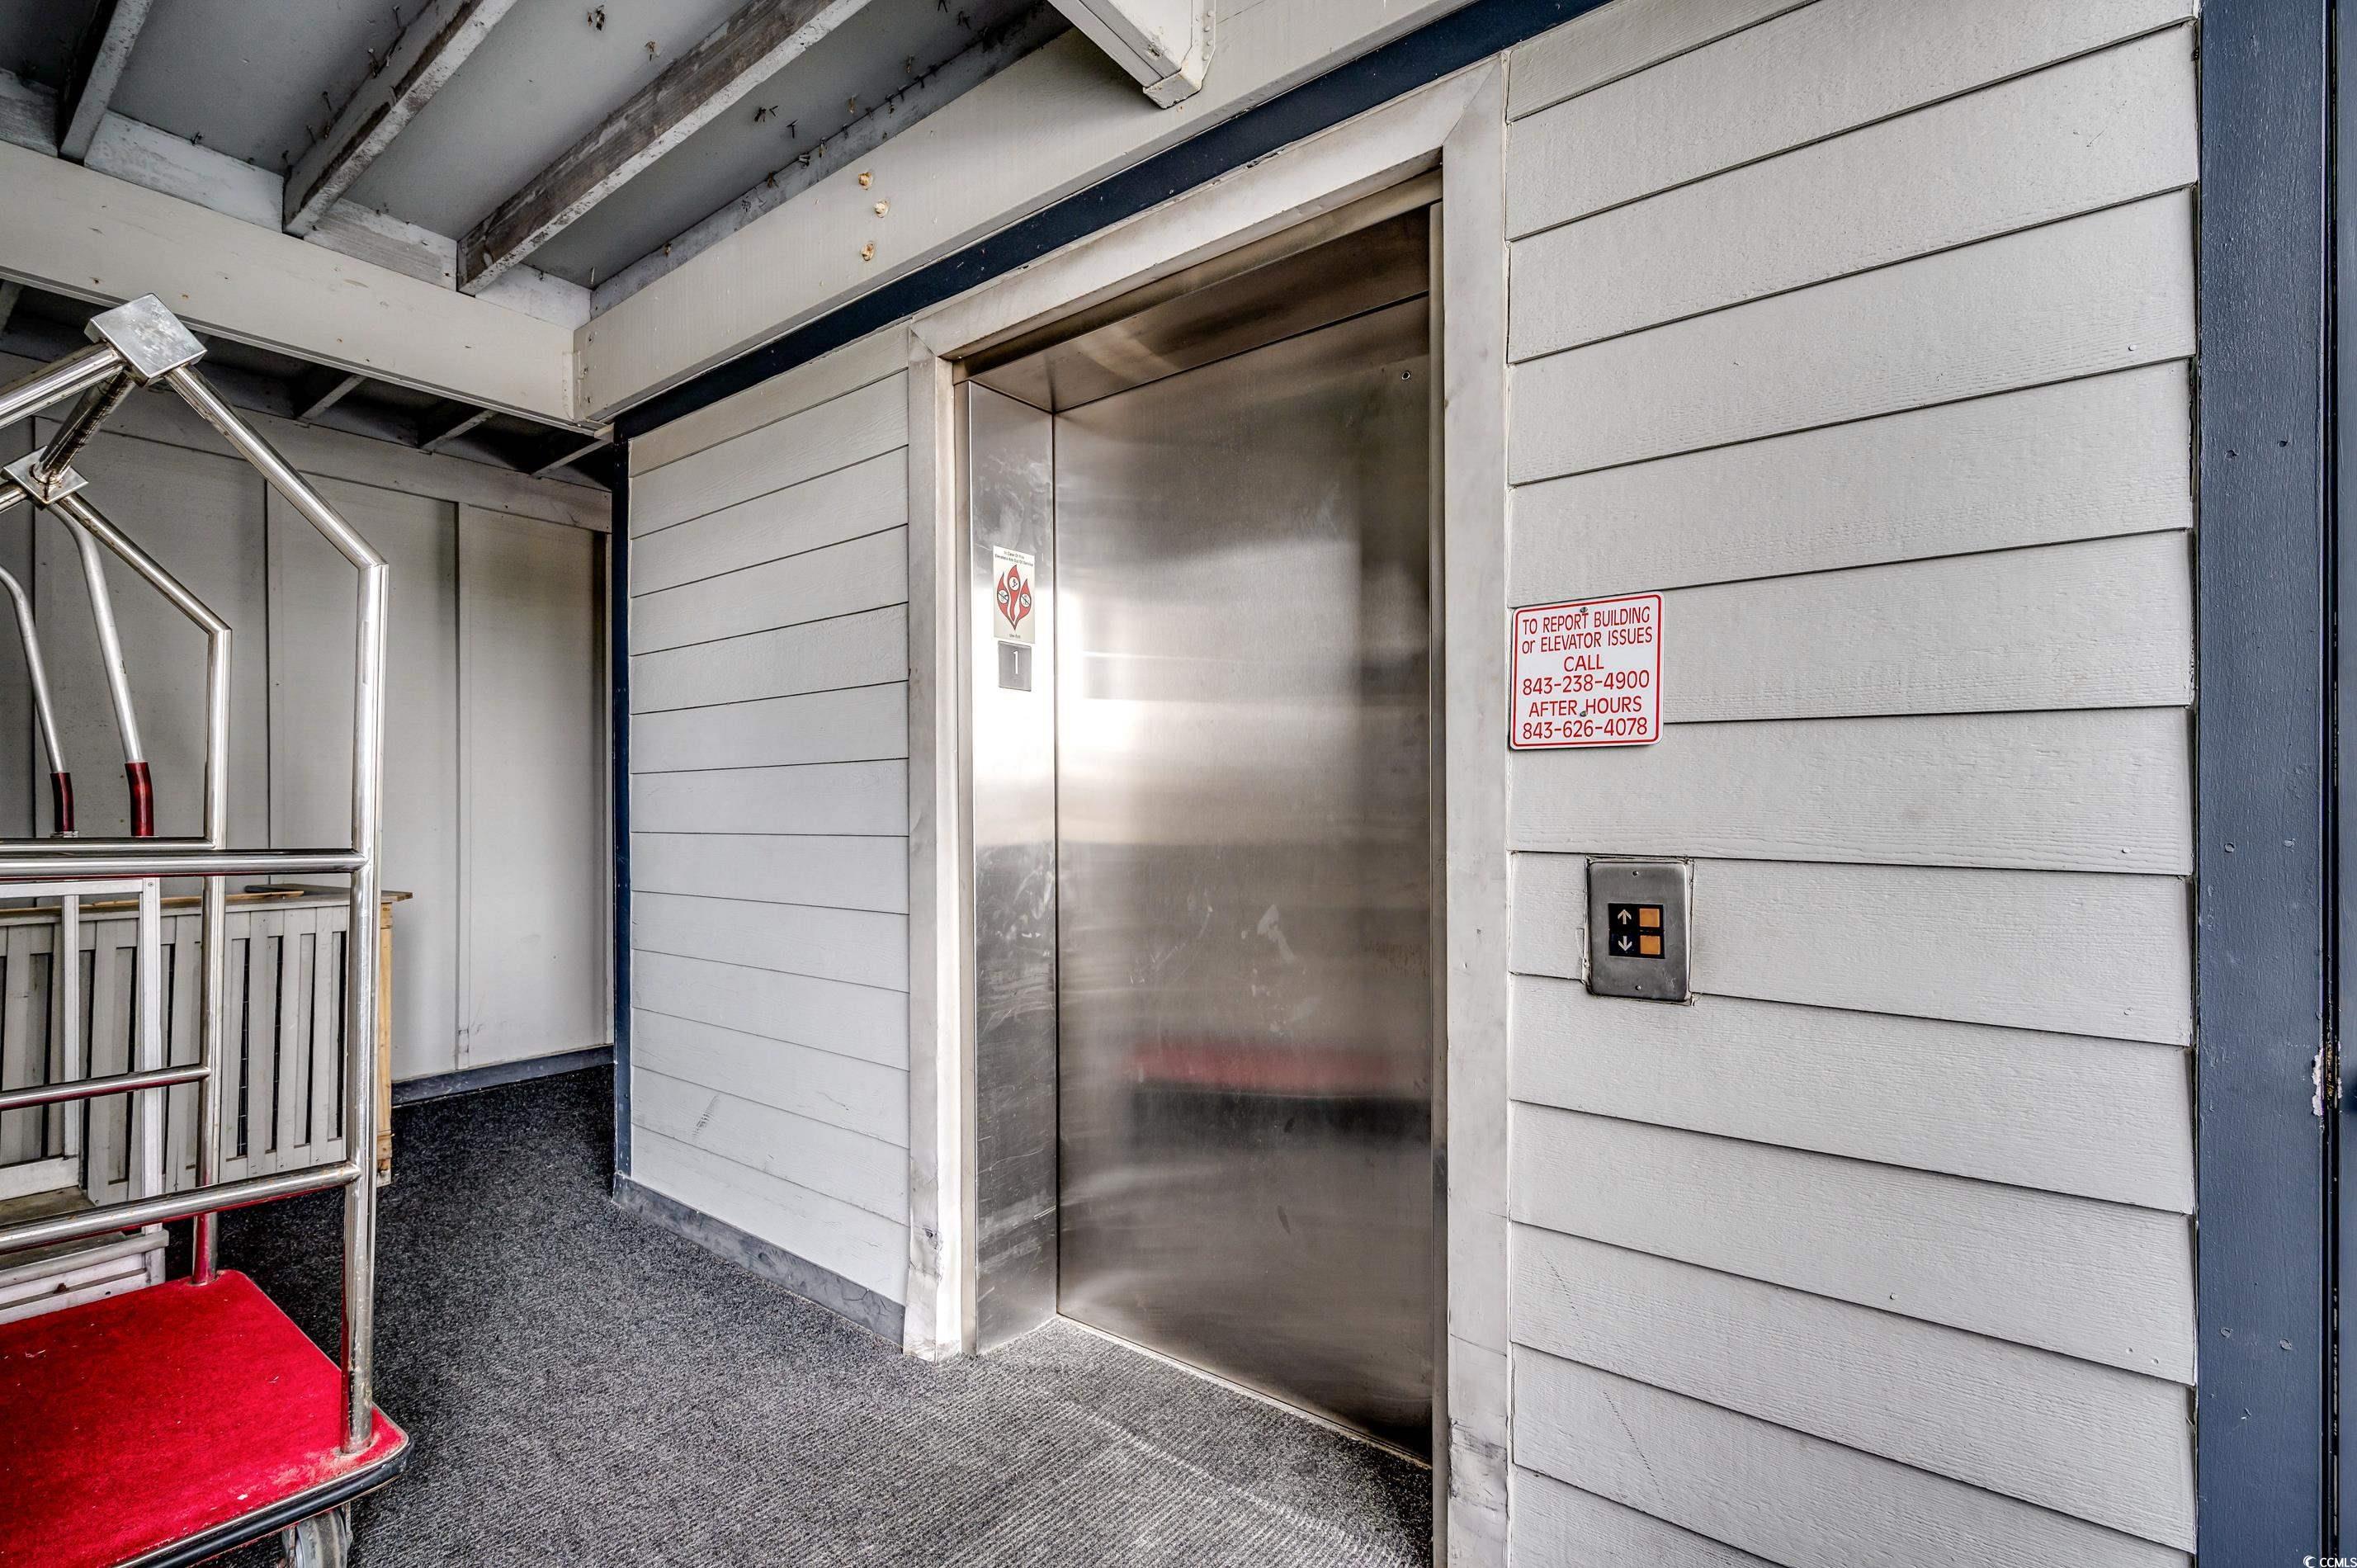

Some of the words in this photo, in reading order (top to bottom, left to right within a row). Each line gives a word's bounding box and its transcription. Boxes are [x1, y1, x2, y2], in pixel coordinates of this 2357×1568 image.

[1523, 618, 1537, 635] TO
[1542, 612, 1589, 633] REPORT
[1594, 607, 1651, 628] BUILDING
[1541, 631, 1602, 652] ELEVATOR
[1608, 626, 1652, 646] ISSUES
[1013, 651, 1018, 674] 1
[1564, 654, 1604, 672] CALL
[1523, 670, 1650, 695] 843-238-4900
[1528, 700, 1577, 717] AFTER
[1585, 696, 1642, 714] HOURS
[1523, 717, 1647, 739] 843-626-4078
